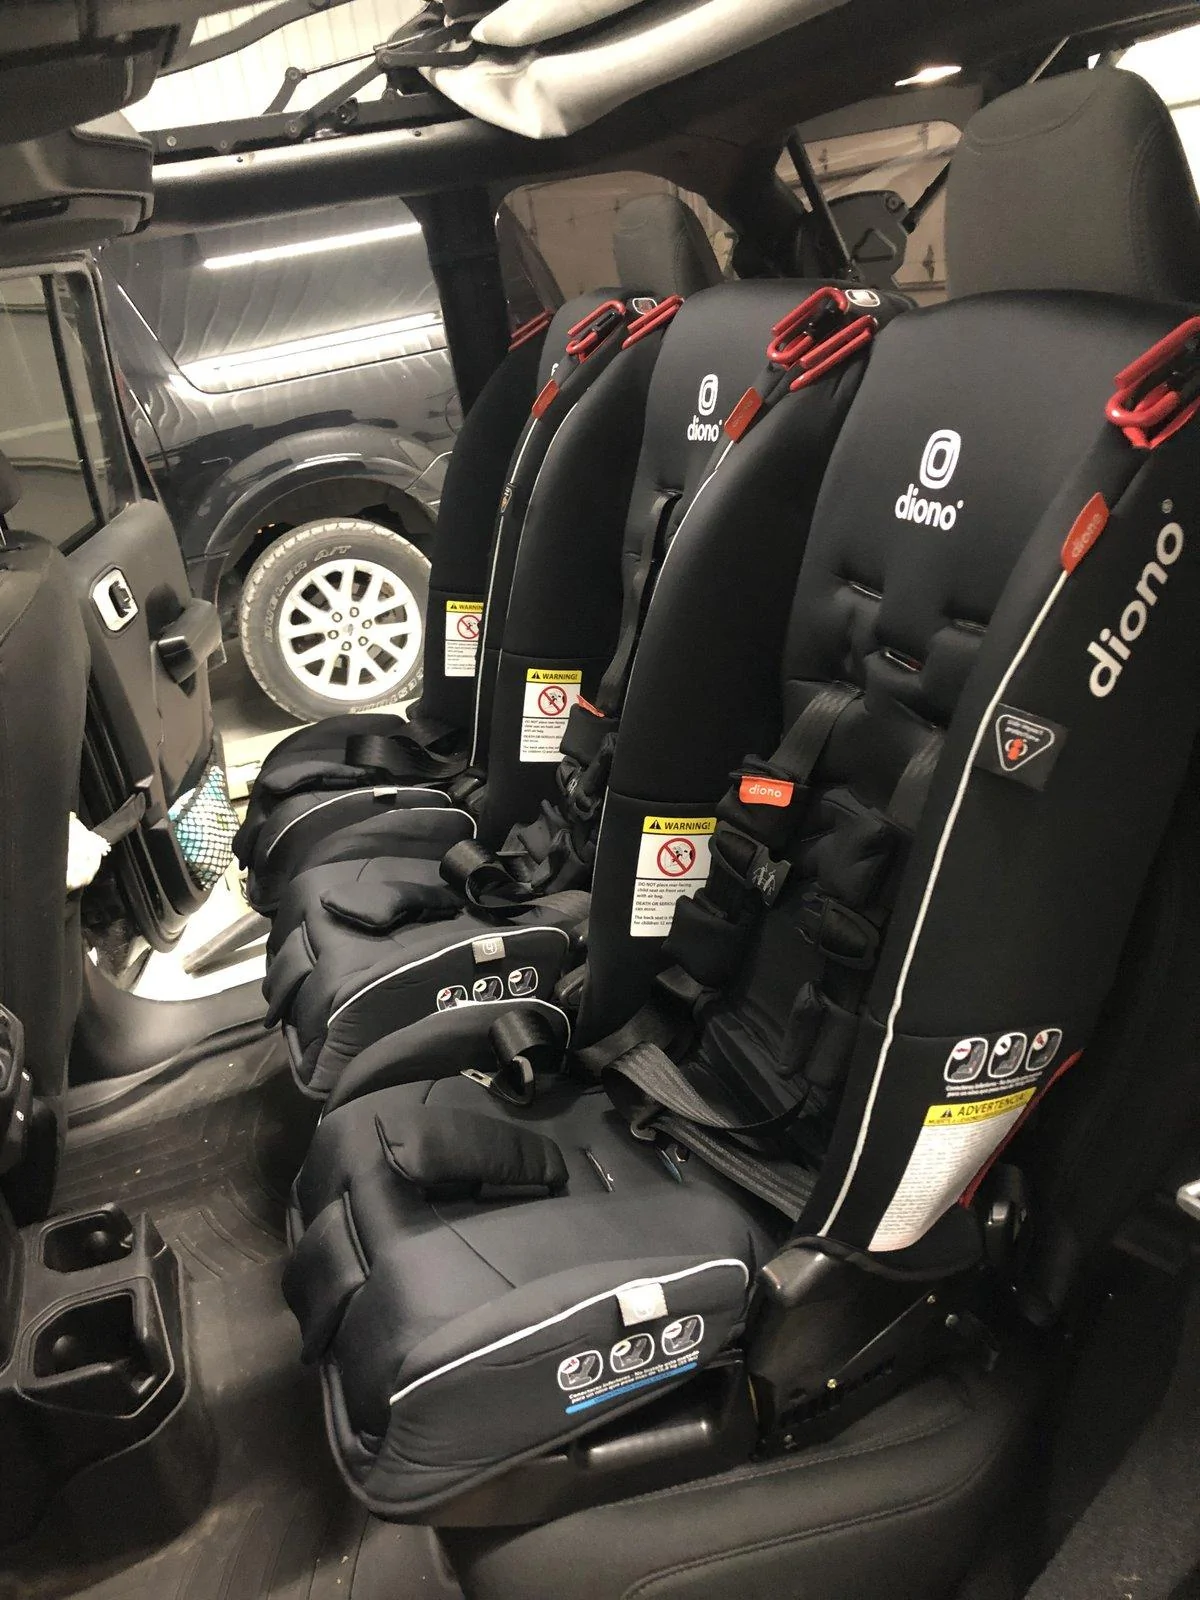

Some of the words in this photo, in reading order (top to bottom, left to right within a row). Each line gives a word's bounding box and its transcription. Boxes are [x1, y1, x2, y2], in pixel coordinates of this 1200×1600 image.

[458, 604, 483, 613] WARNIN
[542, 673, 578, 681] WARNING!
[749, 784, 782, 798] diono
[664, 822, 711, 830] WARNING!
